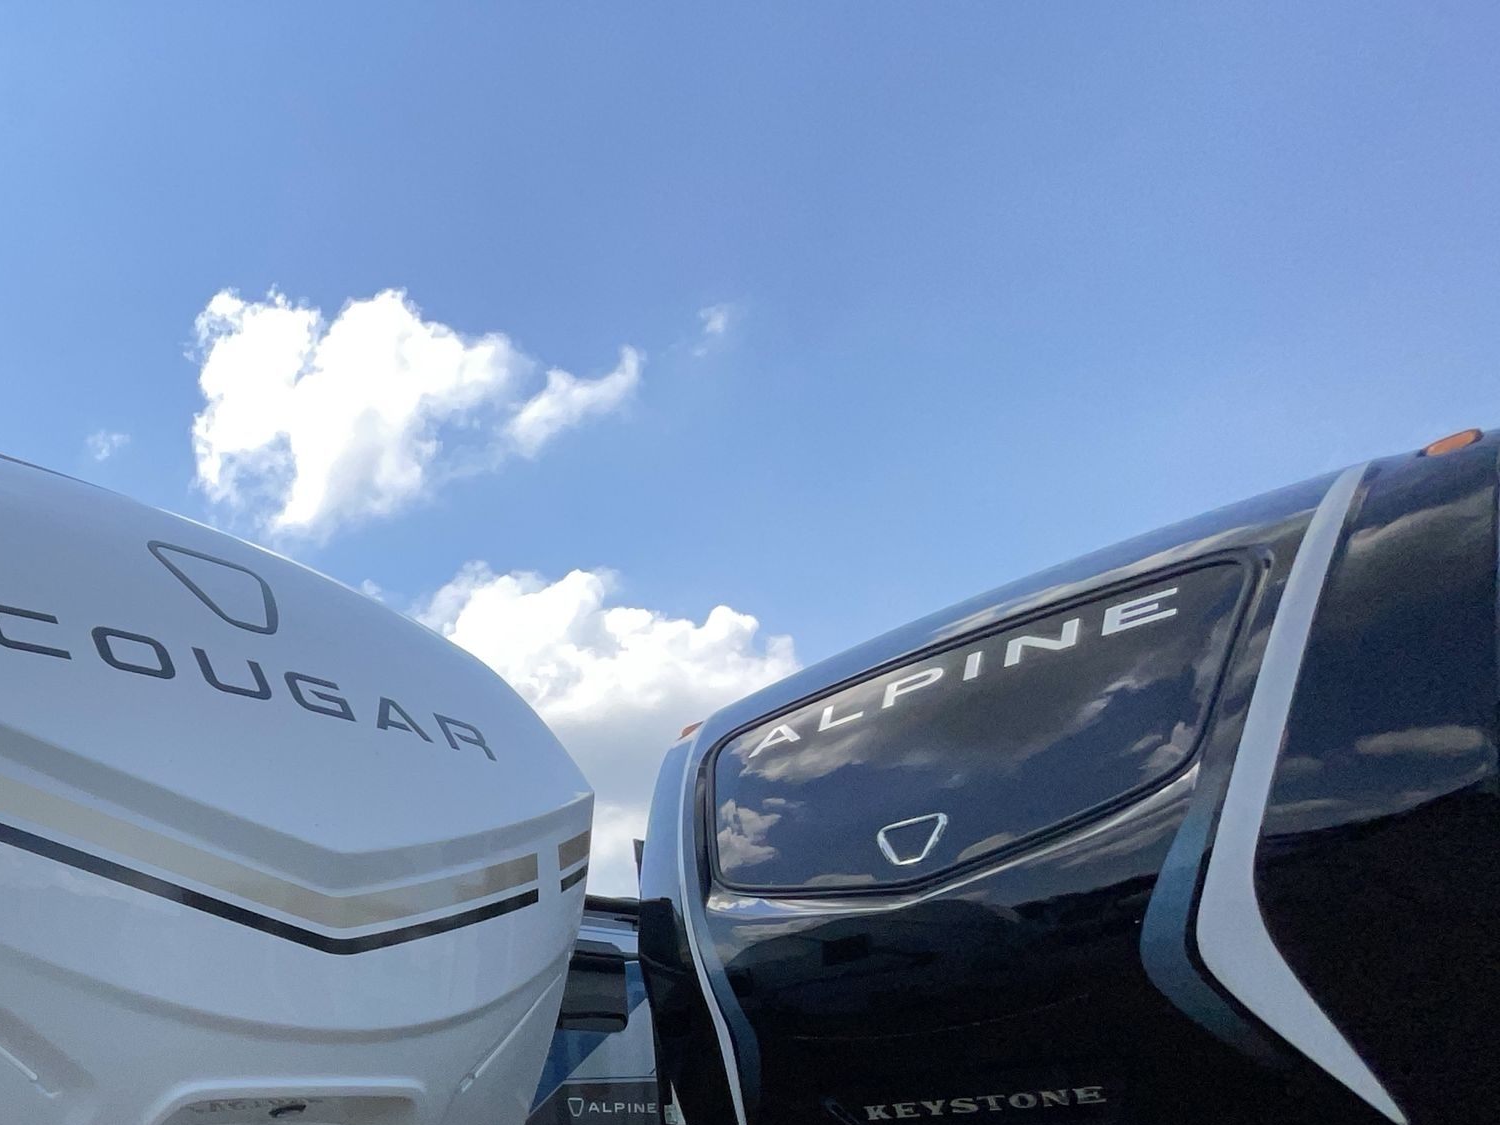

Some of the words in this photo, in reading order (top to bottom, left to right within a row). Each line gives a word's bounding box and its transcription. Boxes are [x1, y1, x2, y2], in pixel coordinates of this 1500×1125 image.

[748, 587, 1178, 758] ALPINE
[588, 1102, 659, 1114] ALPINE
[863, 1086, 1108, 1121] KEYSTONE
